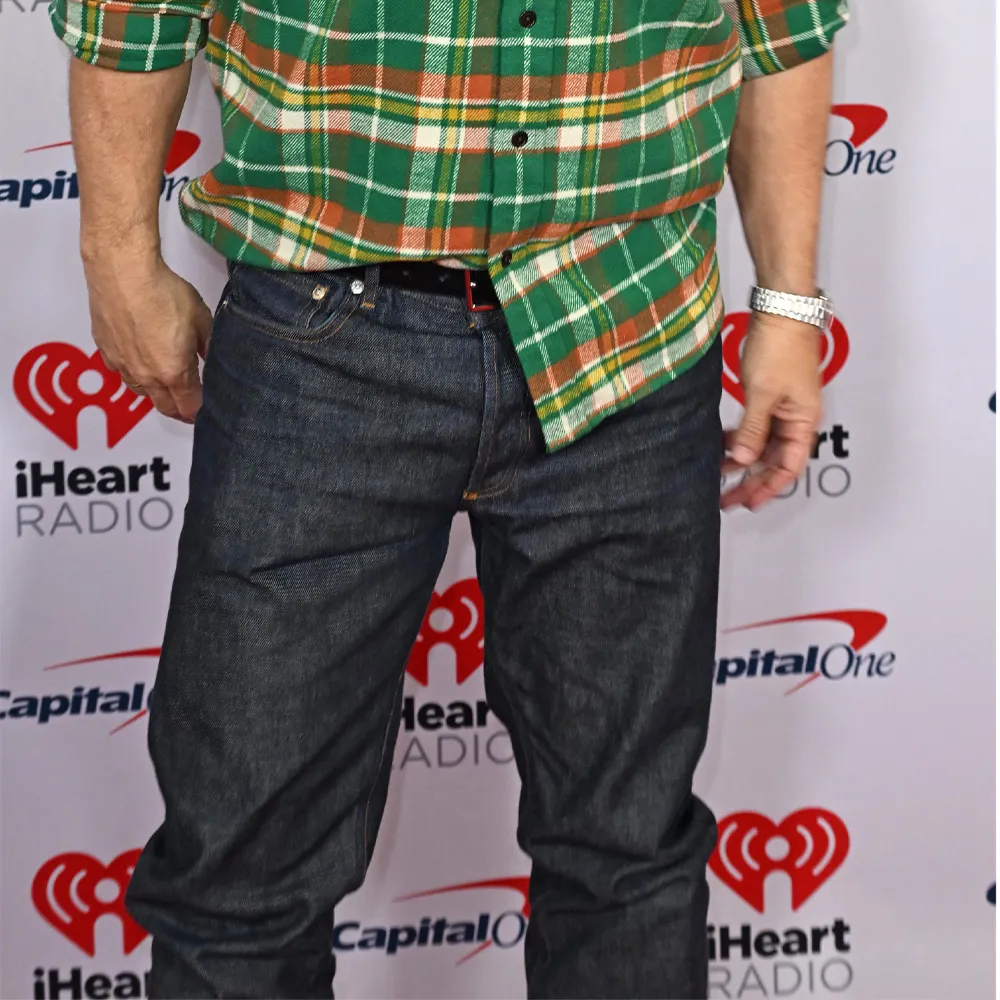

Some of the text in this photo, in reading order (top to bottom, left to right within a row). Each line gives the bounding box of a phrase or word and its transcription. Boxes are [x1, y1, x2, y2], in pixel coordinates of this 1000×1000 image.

[15, 457, 171, 498] iHeart
[17, 497, 173, 537] RADIO
[706, 918, 851, 961] iHeart
[706, 957, 854, 1000] RADIO
